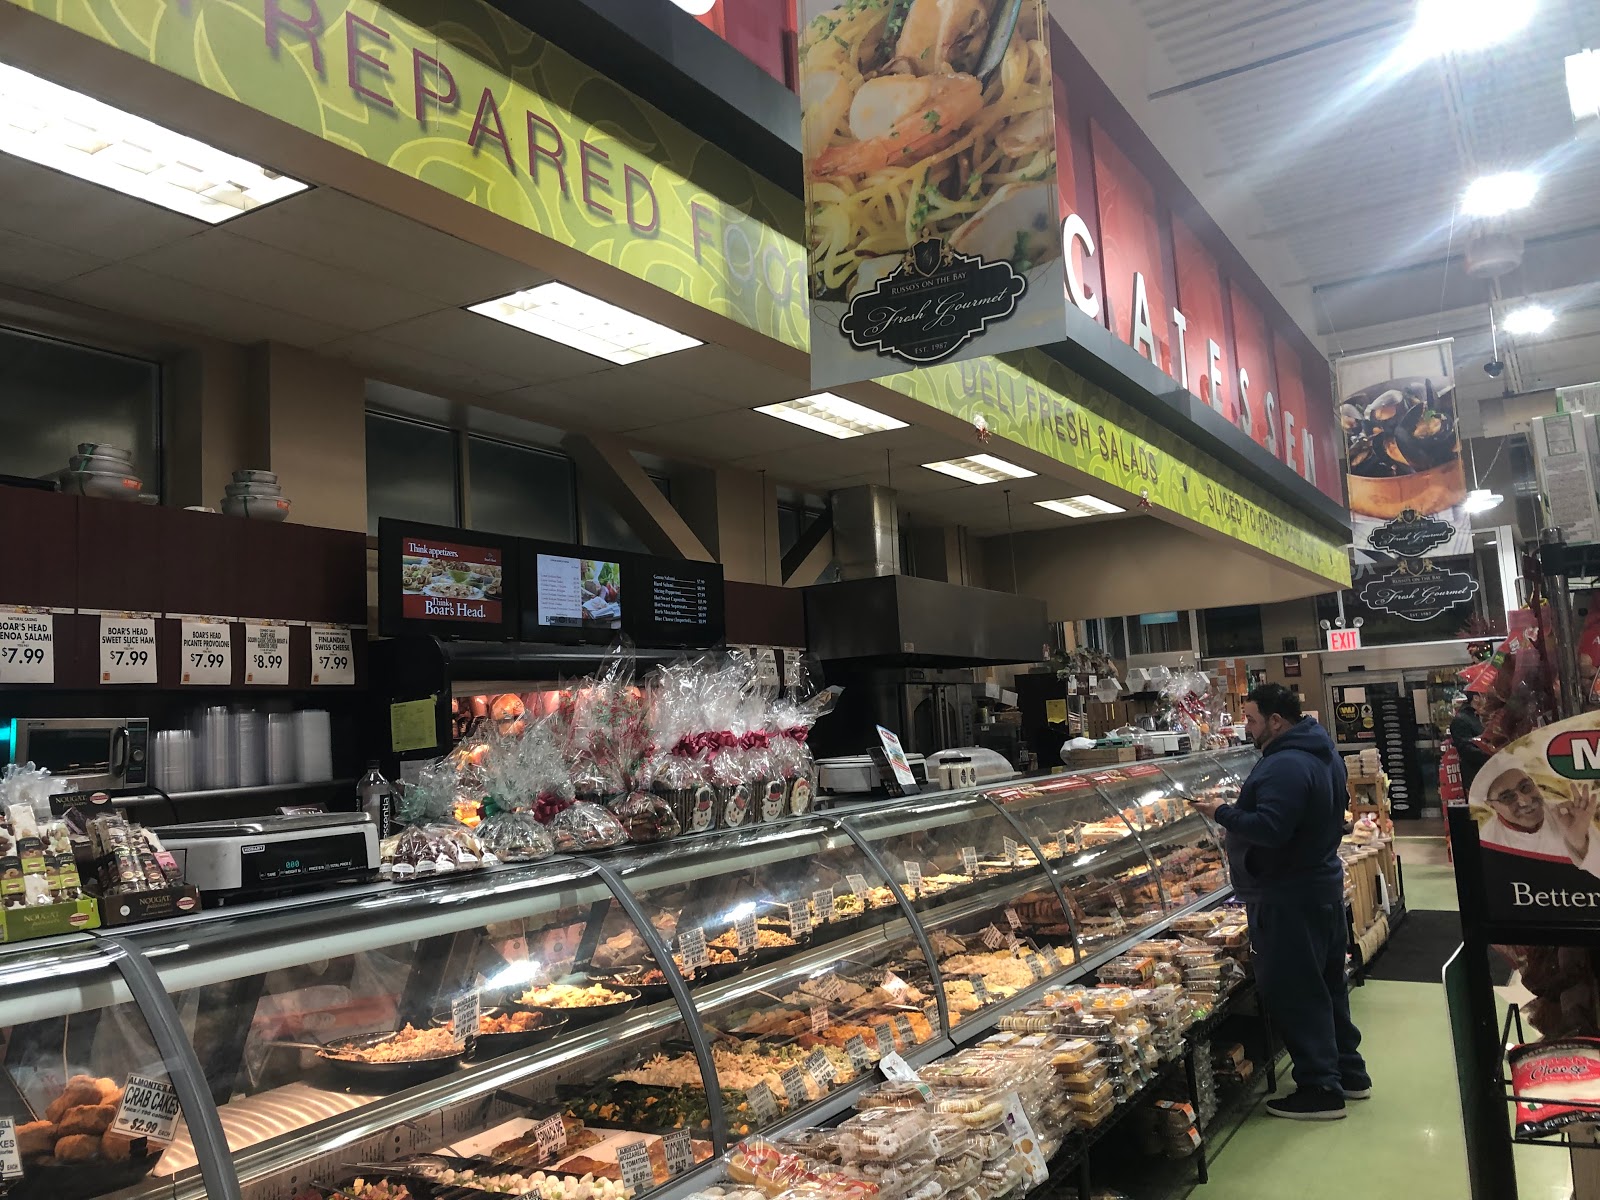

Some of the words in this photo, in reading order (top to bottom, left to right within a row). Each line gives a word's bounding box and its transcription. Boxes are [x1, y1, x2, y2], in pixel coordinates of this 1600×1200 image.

[180, 0, 658, 224] REPARED
[921, 279, 934, 288] ON
[936, 275, 951, 285] THE
[952, 272, 967, 281] BAY
[863, 299, 932, 337] Fresh
[922, 291, 1008, 331] Gourmet
[931, 341, 948, 351] 1987
[1026, 385, 1092, 454] FRESH
[1099, 425, 1159, 485] SALADS
[1206, 483, 1242, 525] SLICED
[1243, 502, 1256, 532] TO
[408, 542, 428, 554] Think
[1375, 588, 1419, 605] Fresh
[1414, 586, 1468, 605] Gourmet
[425, 600, 455, 616] Boar's
[457, 602, 486, 618] Head.
[27, 624, 48, 632] HEAD
[108, 627, 131, 635] BOAR'S
[131, 628, 149, 636] HEAD
[192, 631, 209, 639] BOAR'S
[0, 631, 23, 641] ENOA
[24, 632, 52, 642] SALAMI
[102, 636, 122, 644] SWEET
[123, 636, 139, 644] SLICE
[140, 637, 154, 645] HAM
[183, 639, 203, 647] PICANTE
[203, 640, 230, 648] PROVOLONE
[318, 636, 346, 644] FINLANDIA
[1331, 631, 1357, 650] EXIT
[315, 643, 332, 651] SWISS
[332, 644, 350, 652] CHEESE
[1, 647, 45, 664] $7.99
[110, 651, 148, 666] $7.99
[190, 653, 224, 668] $7.99
[253, 655, 283, 669] $8.99
[319, 656, 348, 670] $7.99
[55, 795, 87, 804] NOUGAT
[139, 895, 171, 905] NOUGAT
[1511, 882, 1600, 908] Better
[453, 999, 479, 1016] CHICKEN
[1529, 1064, 1588, 1081] Cheese
[124, 1086, 152, 1108] CRAB
[151, 1092, 179, 1116] CAKES
[130, 1118, 158, 1134] $2.99
[158, 1129, 171, 1138] EACH
[0, 1139, 15, 1148] KES
[626, 1155, 649, 1168] TOMATOES
